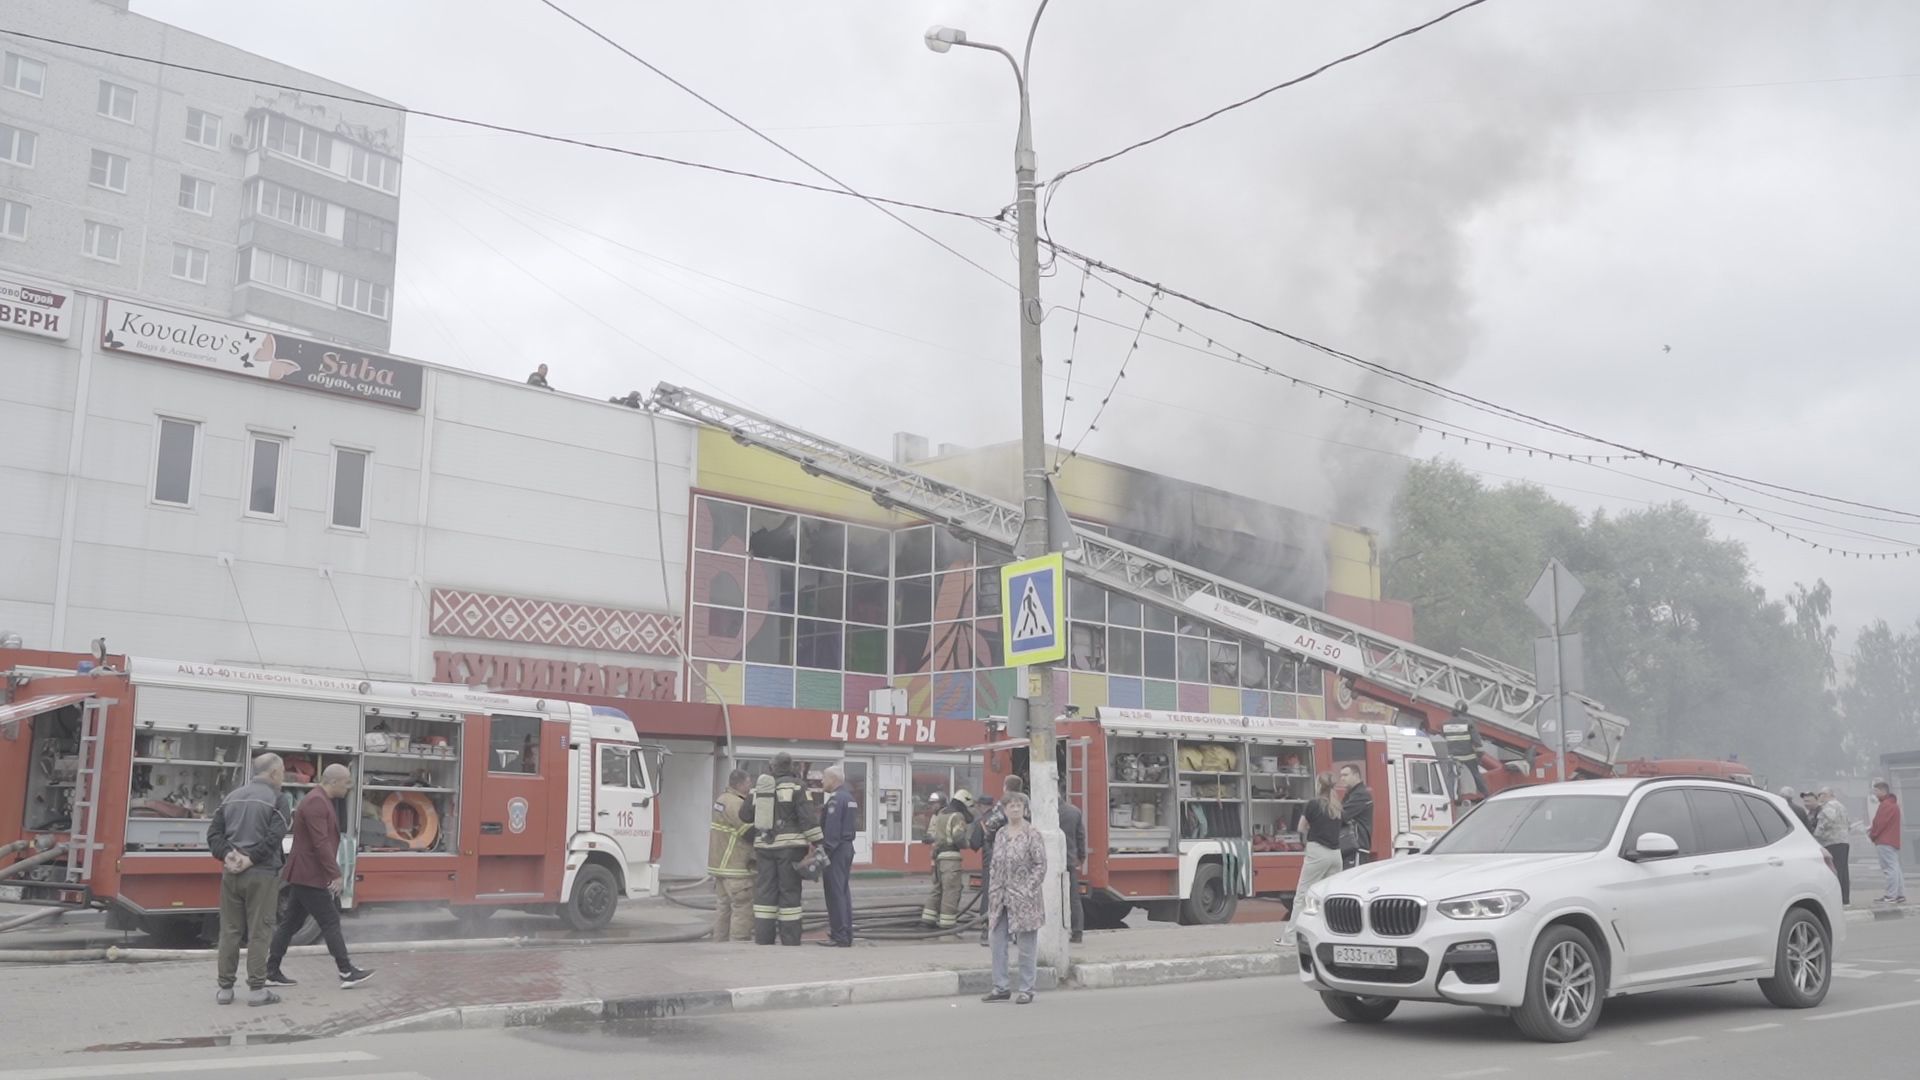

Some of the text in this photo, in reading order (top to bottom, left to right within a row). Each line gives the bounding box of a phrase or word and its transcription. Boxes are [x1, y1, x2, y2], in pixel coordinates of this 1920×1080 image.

[319, 352, 394, 385] Suba
[356, 383, 402, 400] сумки
[178, 665, 194, 676] АЦ
[232, 671, 291, 683] ТЕЛЕФОН
[831, 714, 937, 743] ЦВЕТЫ
[1167, 714, 1216, 725] ТЕЛЕФОН
[617, 811, 634, 828] 116
[1420, 803, 1435, 821] 24
